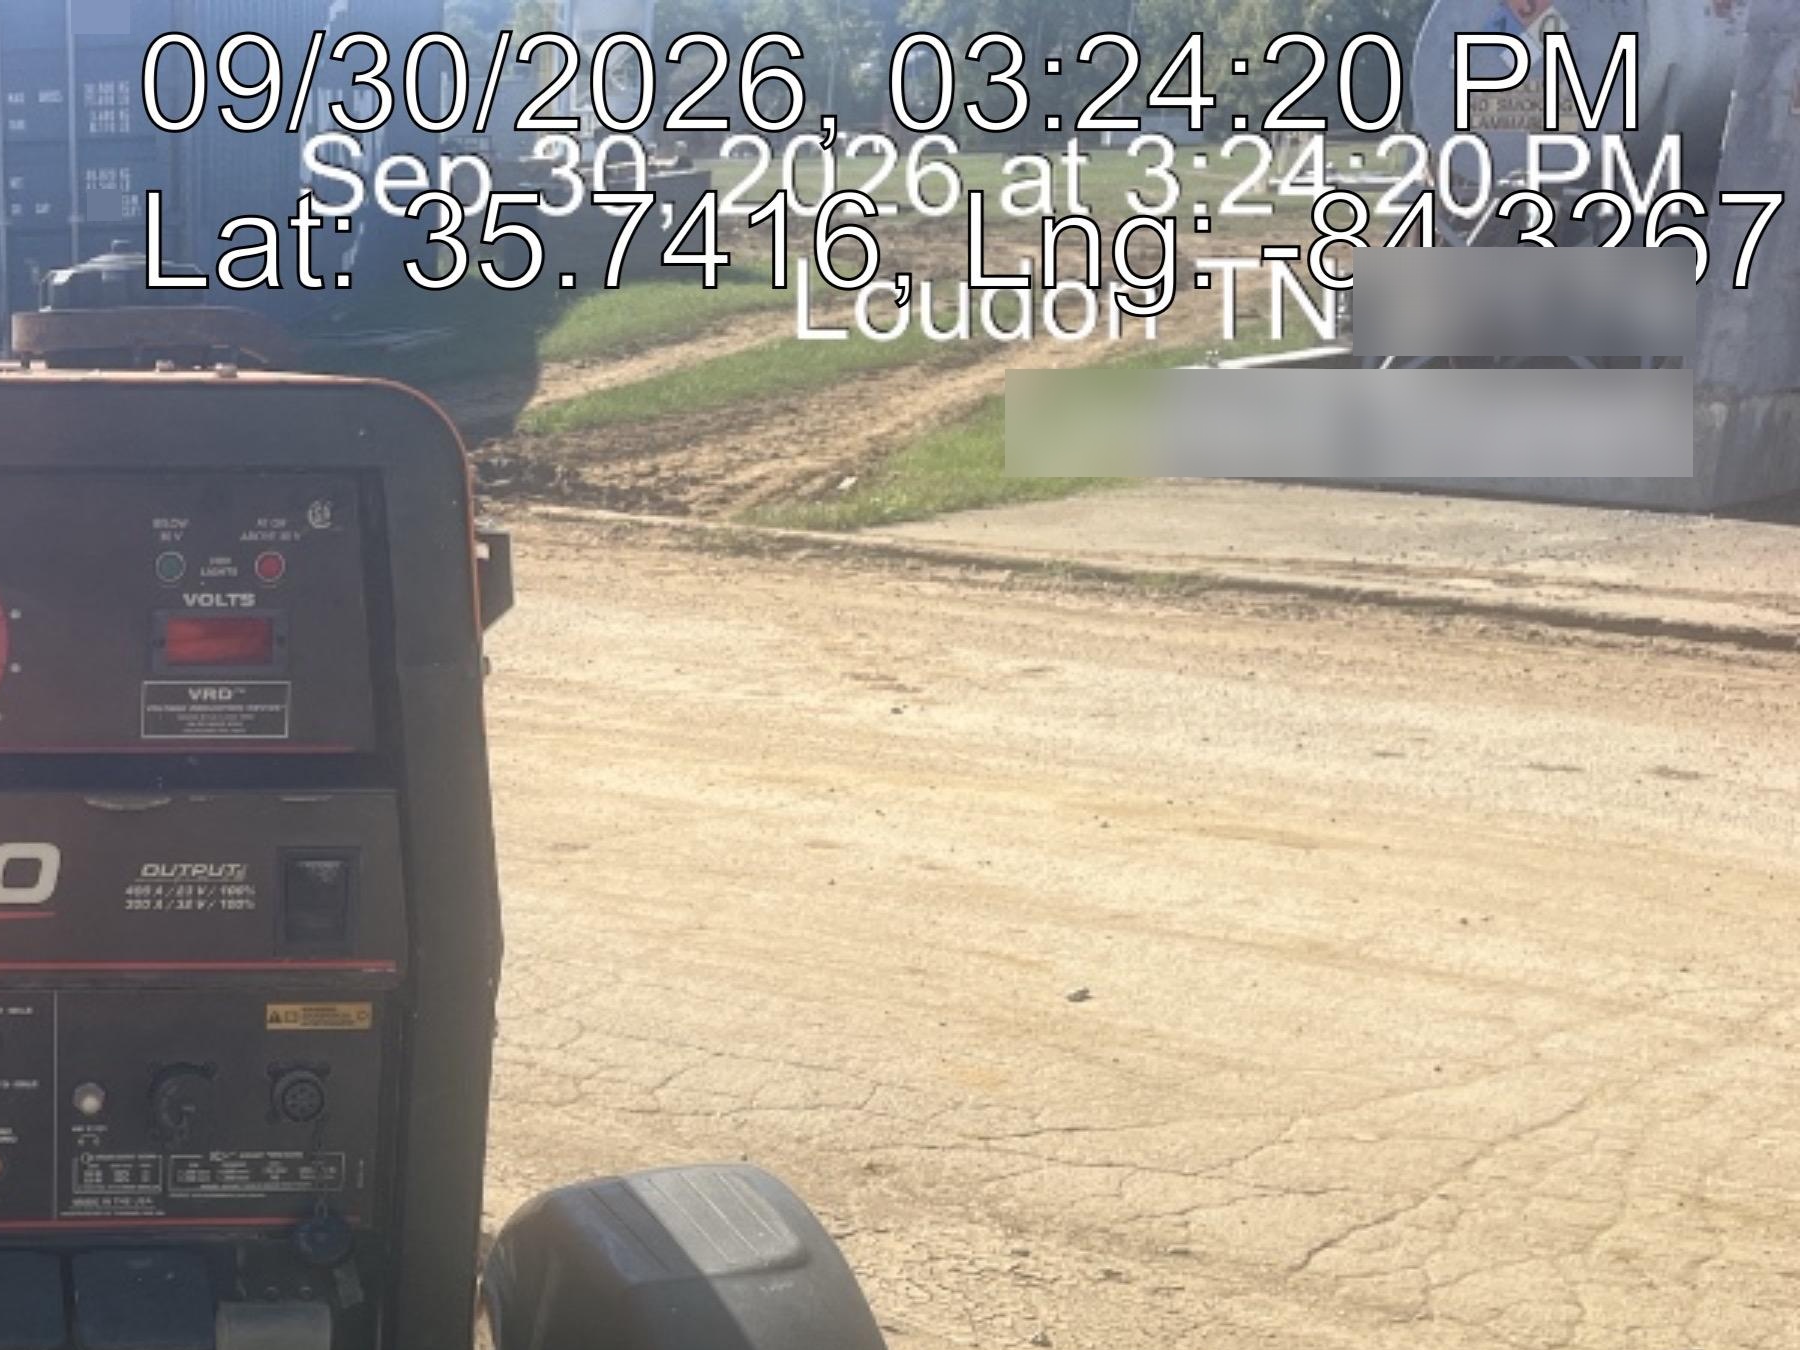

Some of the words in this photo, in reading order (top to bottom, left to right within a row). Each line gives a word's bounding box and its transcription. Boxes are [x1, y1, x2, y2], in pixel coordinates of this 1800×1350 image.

[1497, 99, 1572, 112] SMOKG
[182, 593, 256, 607] VOLTS
[140, 863, 246, 879] OUTPUT
